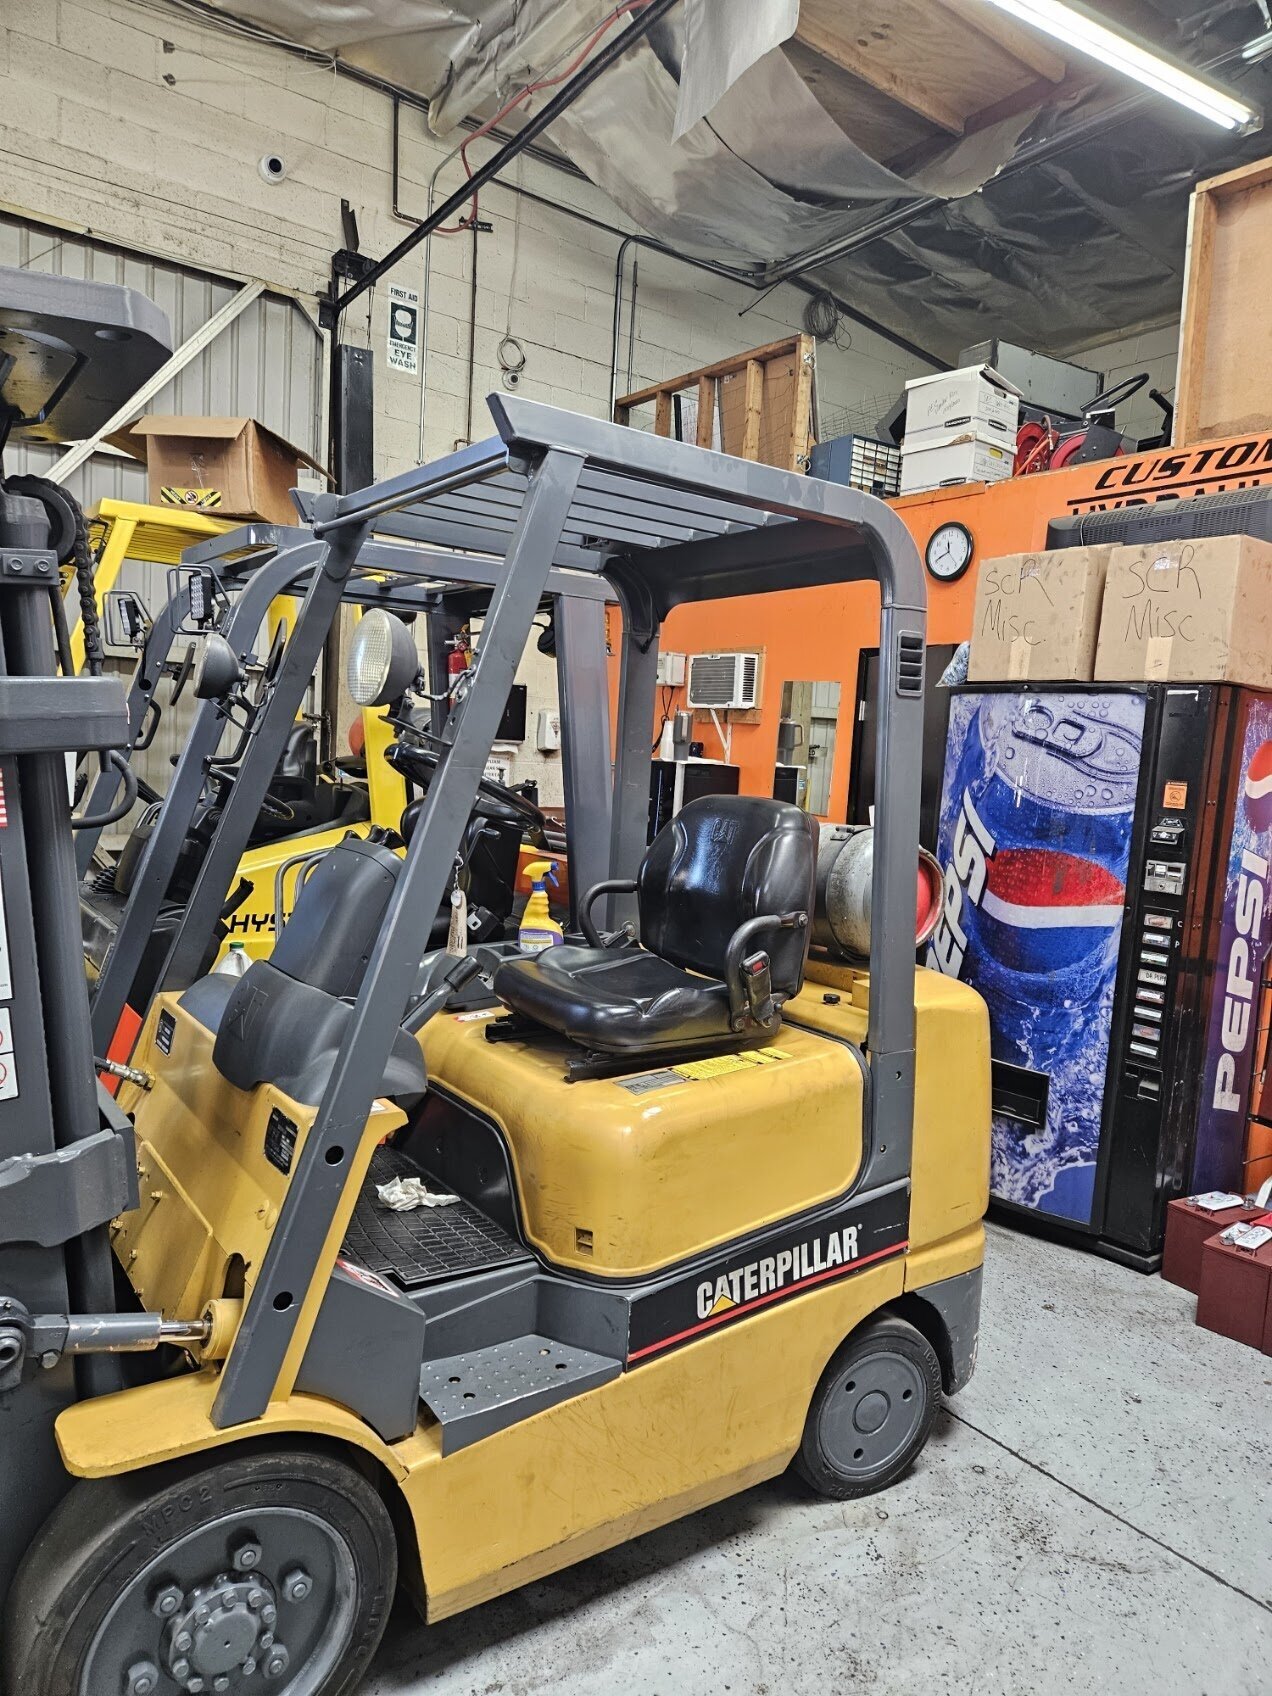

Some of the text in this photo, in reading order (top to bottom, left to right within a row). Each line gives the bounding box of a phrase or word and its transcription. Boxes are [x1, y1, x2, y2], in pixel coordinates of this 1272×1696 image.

[391, 287, 418, 302] FIRST AID
[389, 357, 416, 370] WASH
[394, 349, 412, 360] EYE
[984, 558, 1055, 607] SCR
[1122, 544, 1203, 600] SCR
[926, 786, 996, 980] EPSI
[1212, 848, 1269, 1113] PEPSI
[696, 1225, 860, 1319] CATERPILLAR
